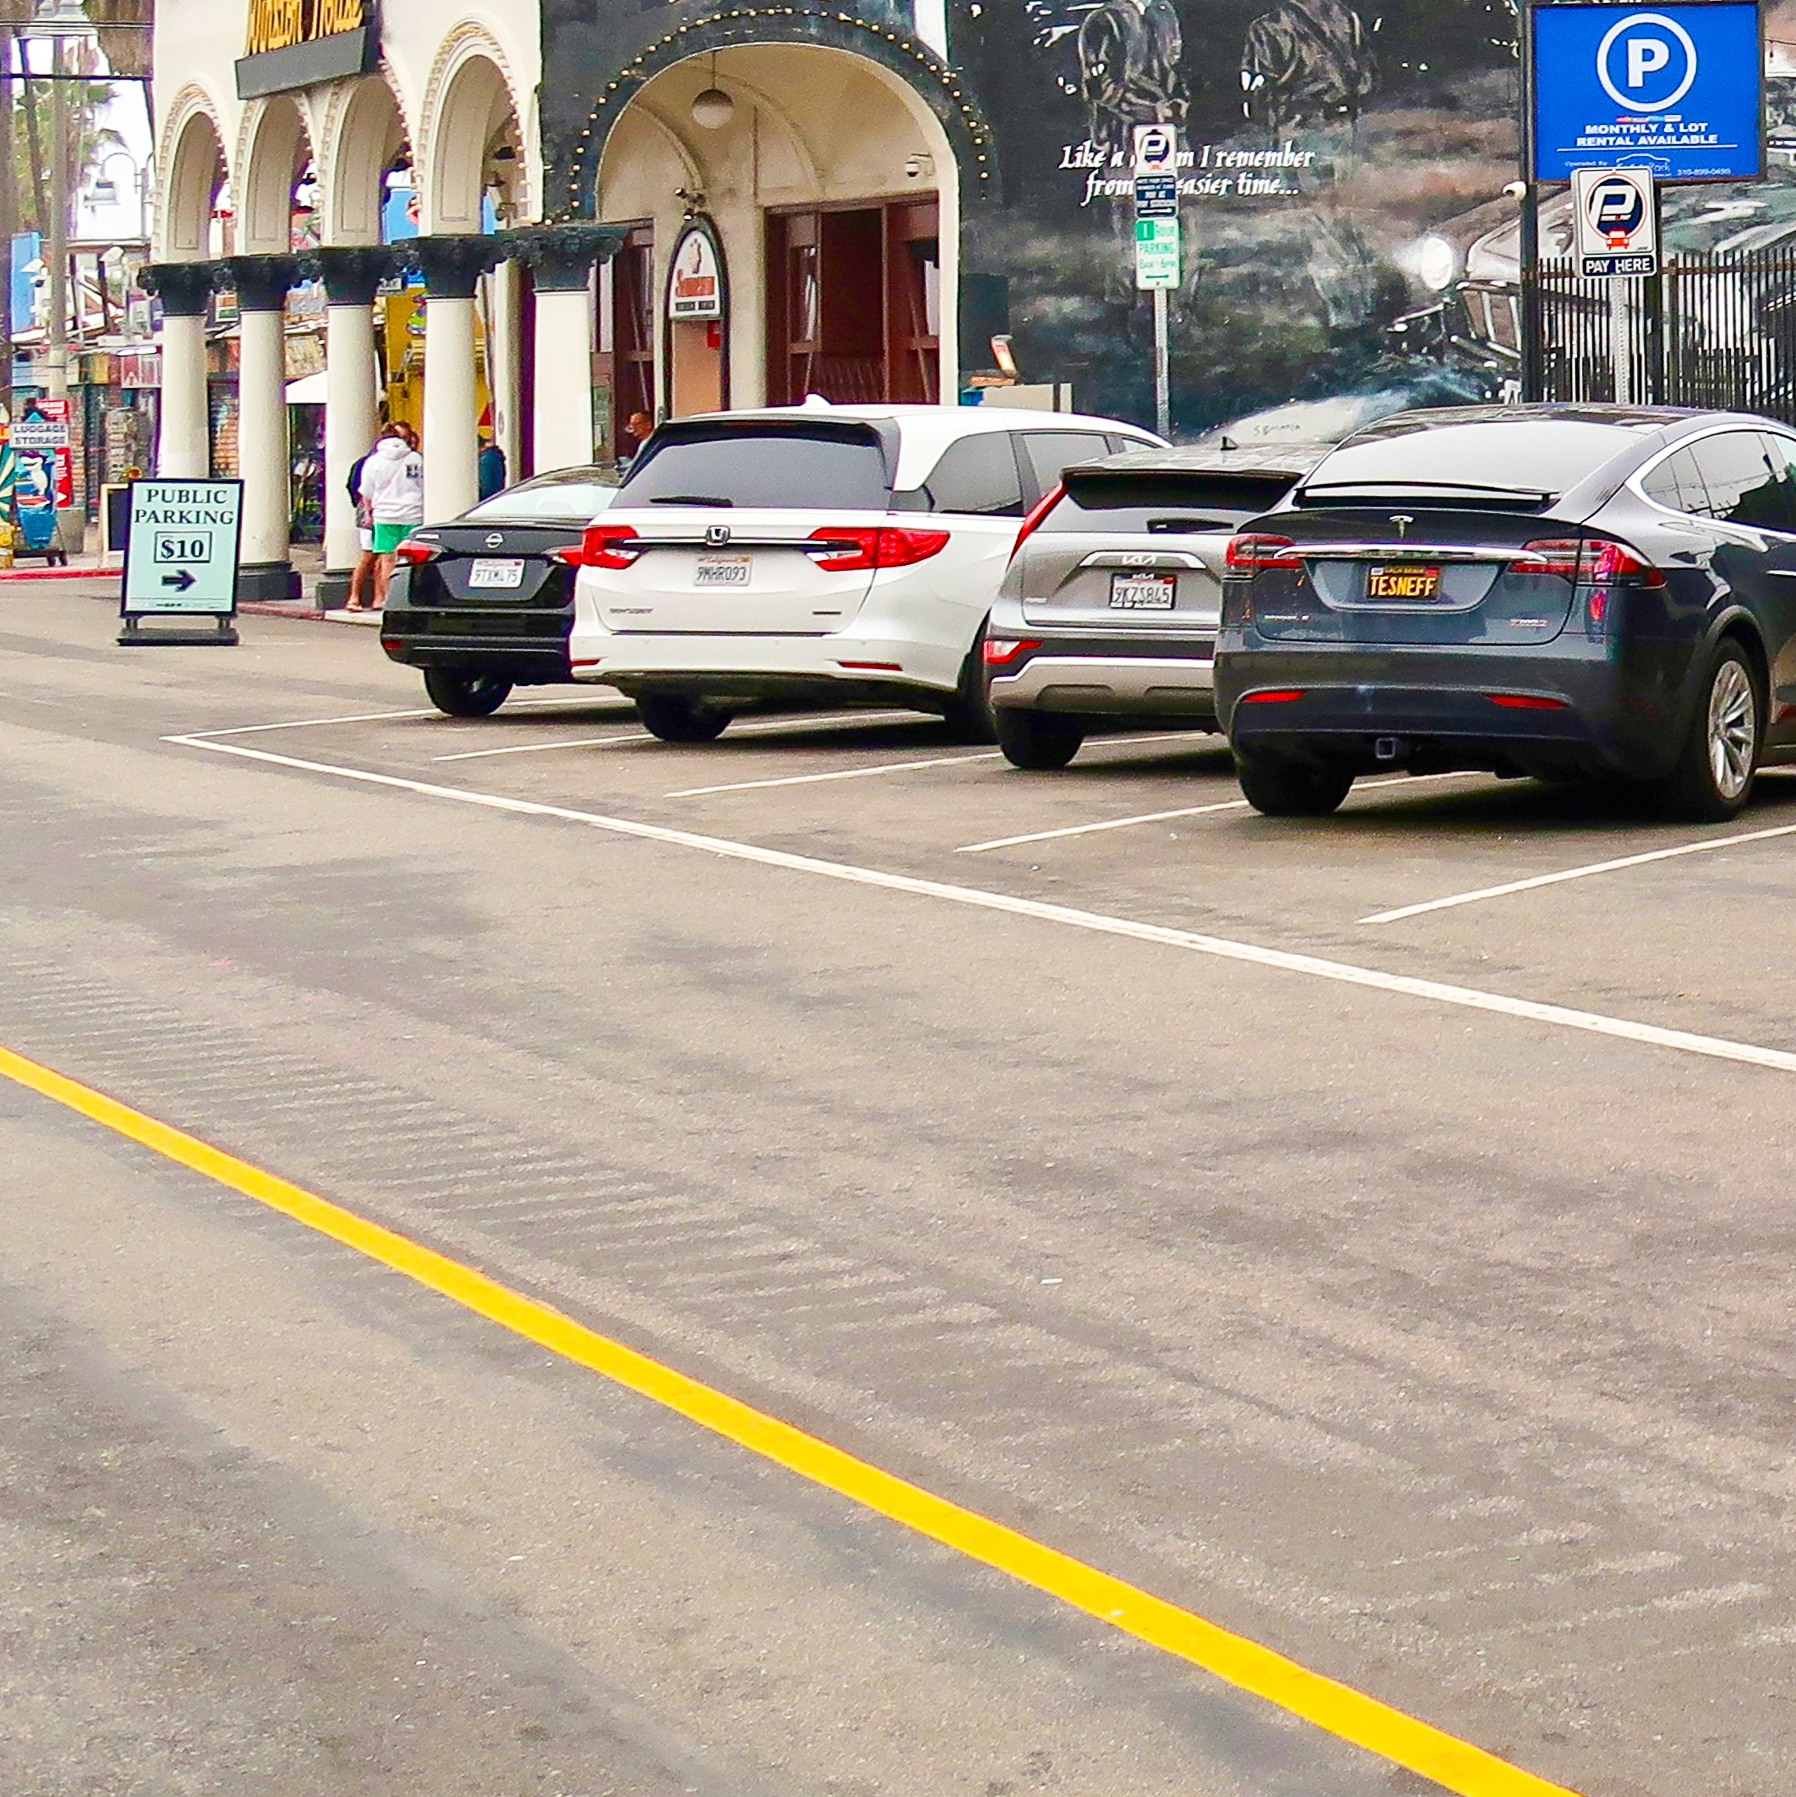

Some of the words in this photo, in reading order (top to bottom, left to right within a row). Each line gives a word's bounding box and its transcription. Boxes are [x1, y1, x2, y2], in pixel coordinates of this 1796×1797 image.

[1628, 38, 1670, 87] P
[1585, 123, 1659, 135] MONTHLY
[1663, 123, 1675, 133] &
[1679, 122, 1709, 133] LOT
[1576, 136, 1635, 147] RENTAL
[1637, 134, 1718, 145] AVAILABLE
[1059, 139, 1106, 170] Like
[1110, 149, 1125, 168] a
[1199, 145, 1212, 169] I
[1216, 139, 1316, 169] remember
[1080, 169, 1134, 207] from
[1236, 171, 1300, 196] time...
[1139, 242, 1176, 254] PARKING
[1585, 260, 1611, 274] PAY
[1617, 257, 1650, 273] HERE
[13, 425, 66, 434] LUGGAGE
[14, 436, 66, 445] STORAGE
[146, 489, 228, 504] PUBLIC
[134, 509, 234, 524] PARKING
[161, 540, 204, 559] $10
[1370, 576, 1437, 597] TESNEFF
